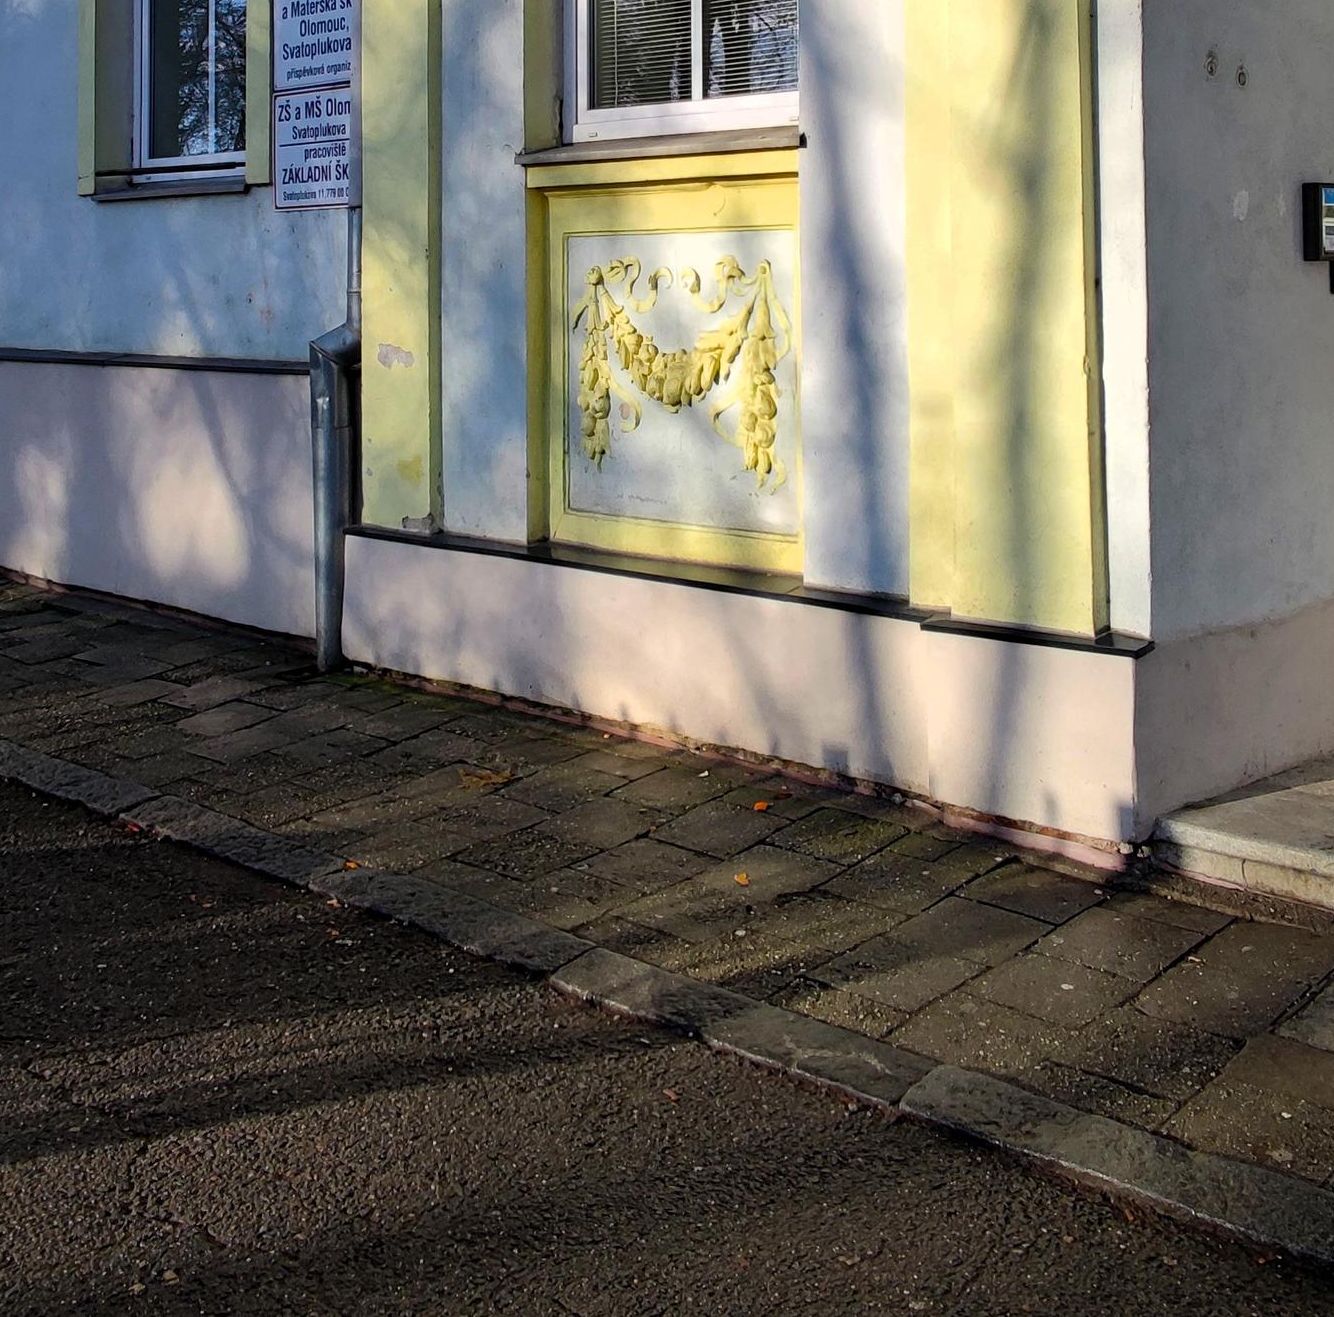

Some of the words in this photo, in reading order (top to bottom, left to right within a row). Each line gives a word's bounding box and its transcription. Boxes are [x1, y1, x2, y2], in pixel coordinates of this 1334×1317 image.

[282, 6, 288, 19] a
[299, 17, 349, 37] Olomouc,
[283, 37, 352, 61] Svatoplukova
[287, 63, 325, 81] příspěvková
[278, 99, 291, 122] ZŠ
[295, 107, 301, 120] a
[305, 95, 322, 119] MŠ
[292, 122, 346, 140] Svatoplukova
[304, 142, 346, 162] pracoviště
[282, 160, 332, 185] ZÁKLADNÍ
